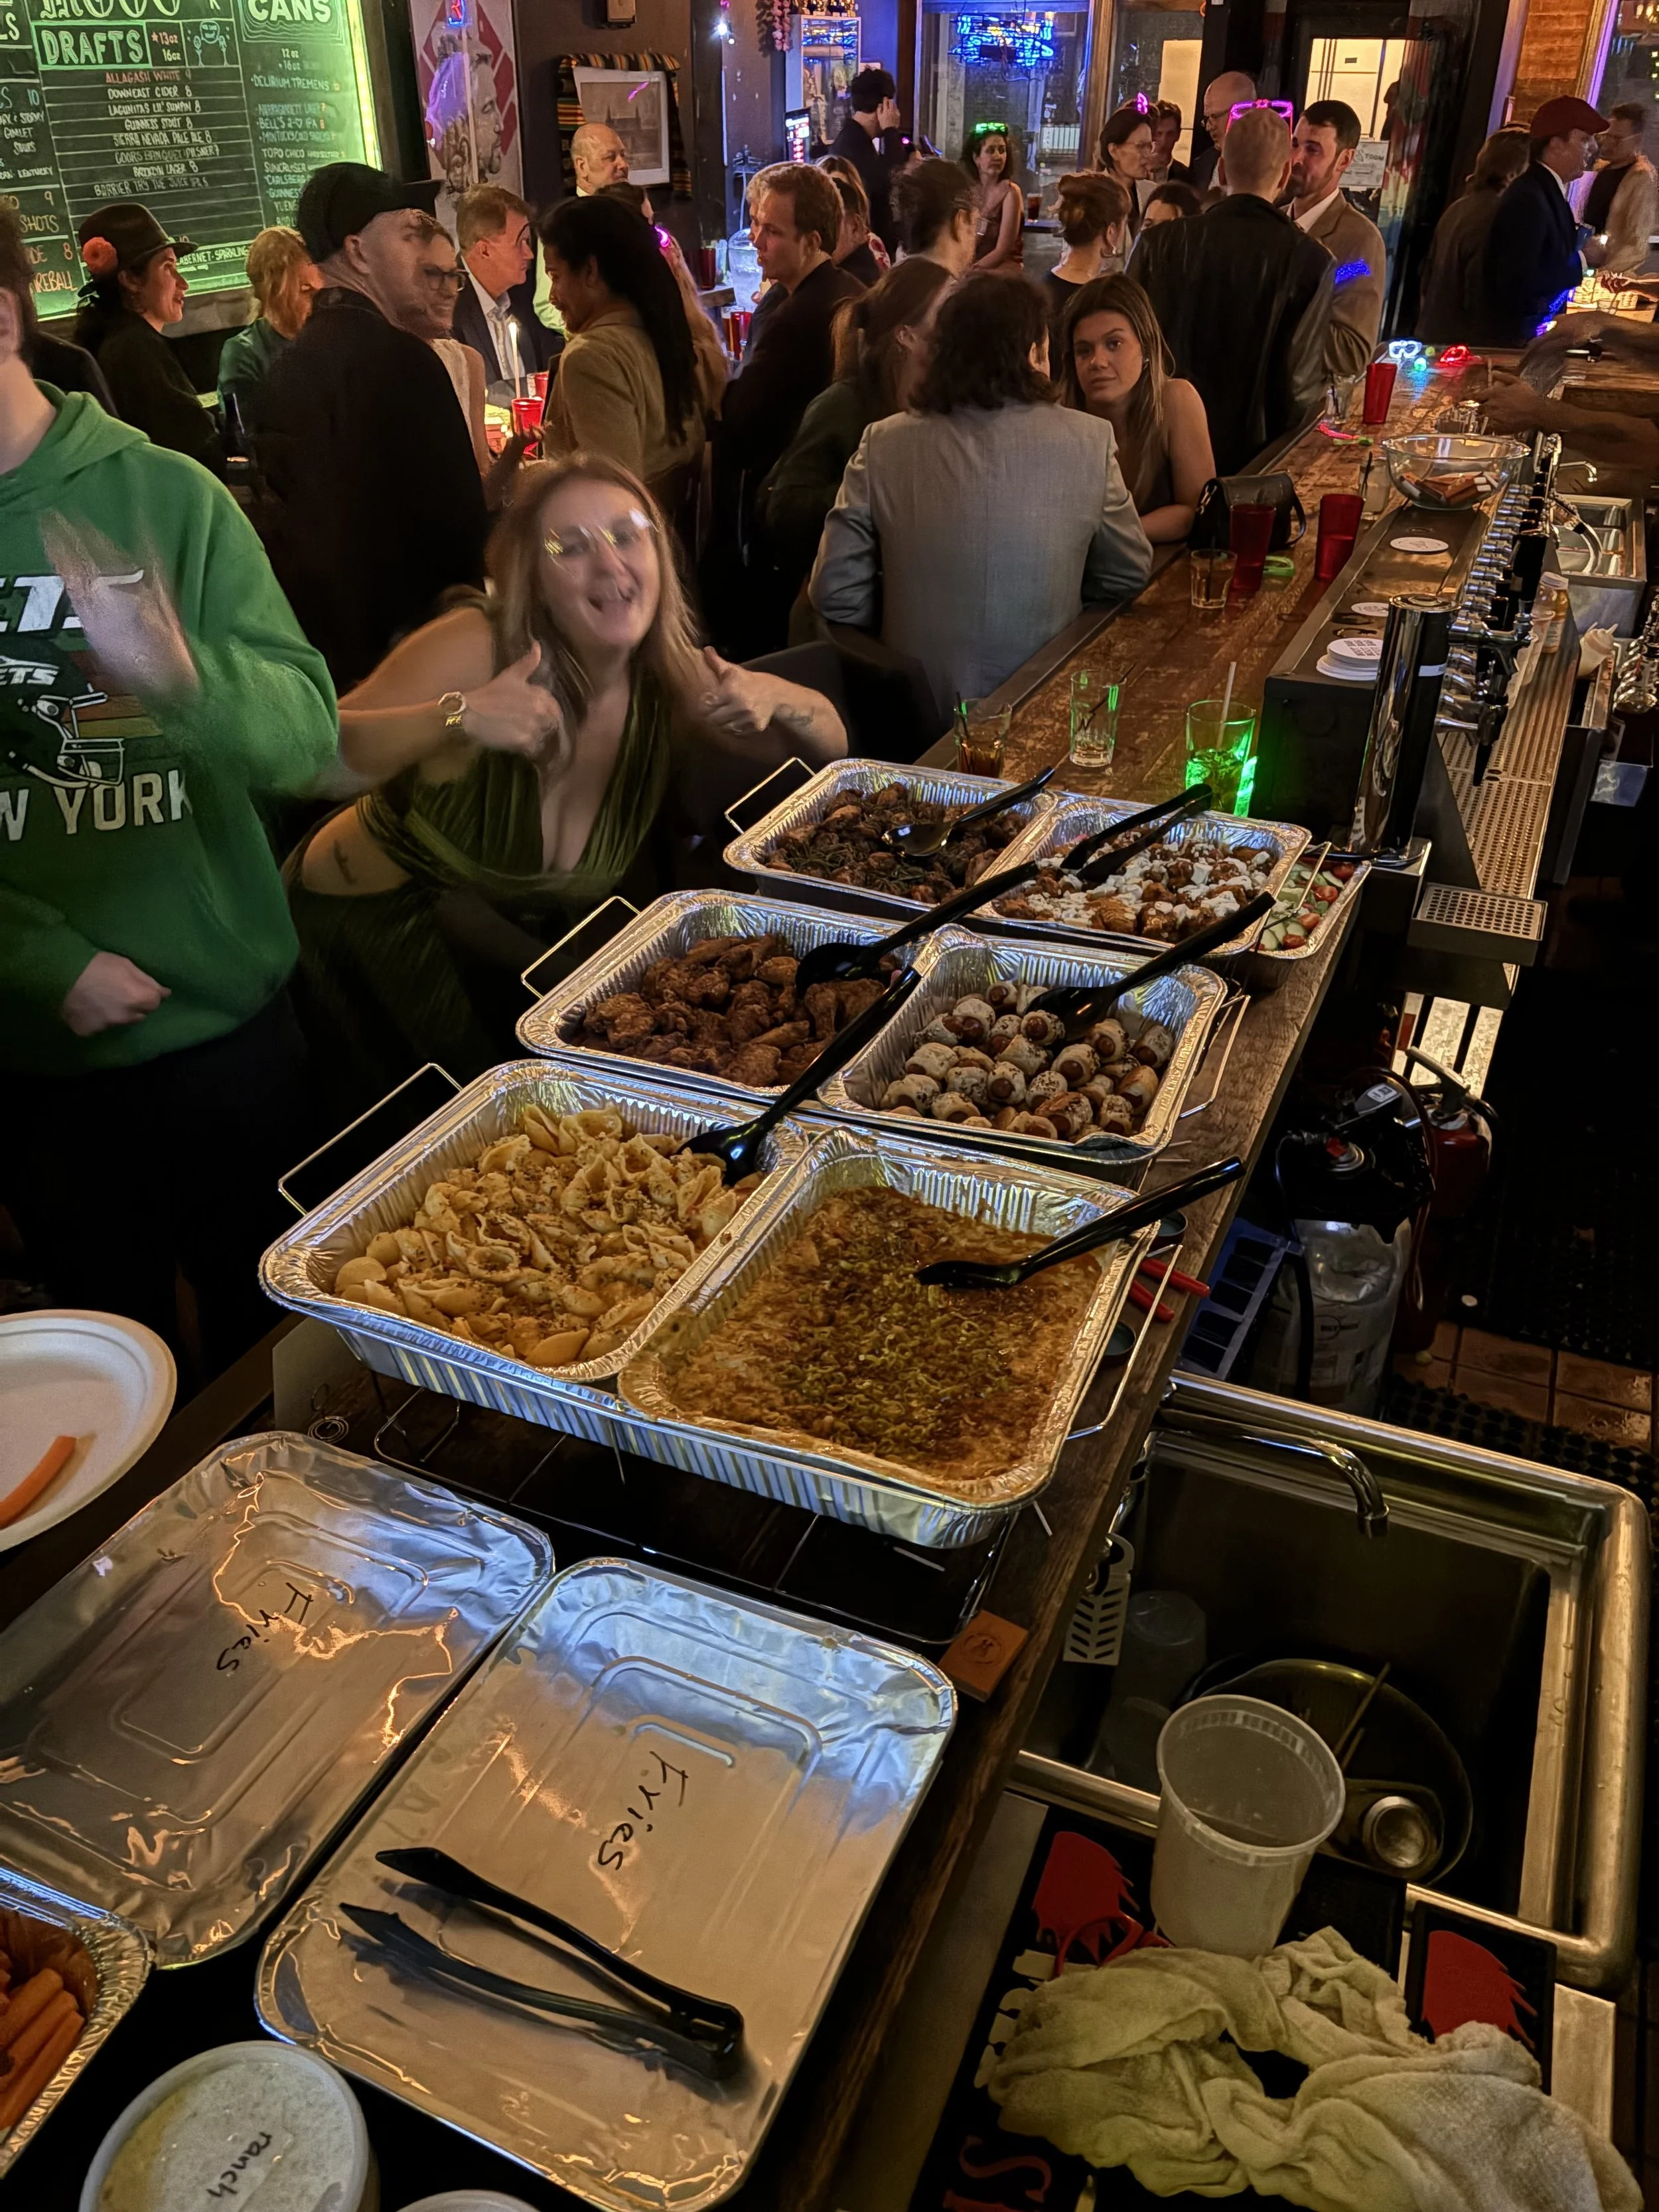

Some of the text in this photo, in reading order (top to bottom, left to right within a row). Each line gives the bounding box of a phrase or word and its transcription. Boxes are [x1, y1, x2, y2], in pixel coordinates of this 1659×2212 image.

[247, 0, 331, 23] CANS
[0, 12, 20, 40] S
[41, 29, 144, 65] DRAFTS
[106, 70, 151, 84] ALLAGASH
[153, 70, 180, 81] WHITE
[253, 74, 291, 89] DELIRIUM
[291, 77, 330, 91] TREMENS
[27, 88, 40, 106] 10
[108, 85, 192, 100] DOWNEAST CIDER 8
[108, 102, 150, 116] LAGUNITAS
[194, 100, 202, 113] 8
[124, 116, 193, 131] GUINNESS STOUT 8
[259, 116, 285, 129] BELL'S
[113, 130, 212, 147] SIERRA NEVADA PALE ALE 8
[115, 151, 143, 164] COORS
[261, 147, 284, 159] TOPO
[285, 148, 305, 159] CHICO
[188, 160, 198, 173] 8
[94, 180, 133, 197] BARRIER
[19, 214, 60, 233] SHOTS
[62, 242, 73, 260] 8
[175, 250, 212, 266] ABERNET
[54, 769, 193, 835] YORK
[206, 2131, 273, 2198] ranch
